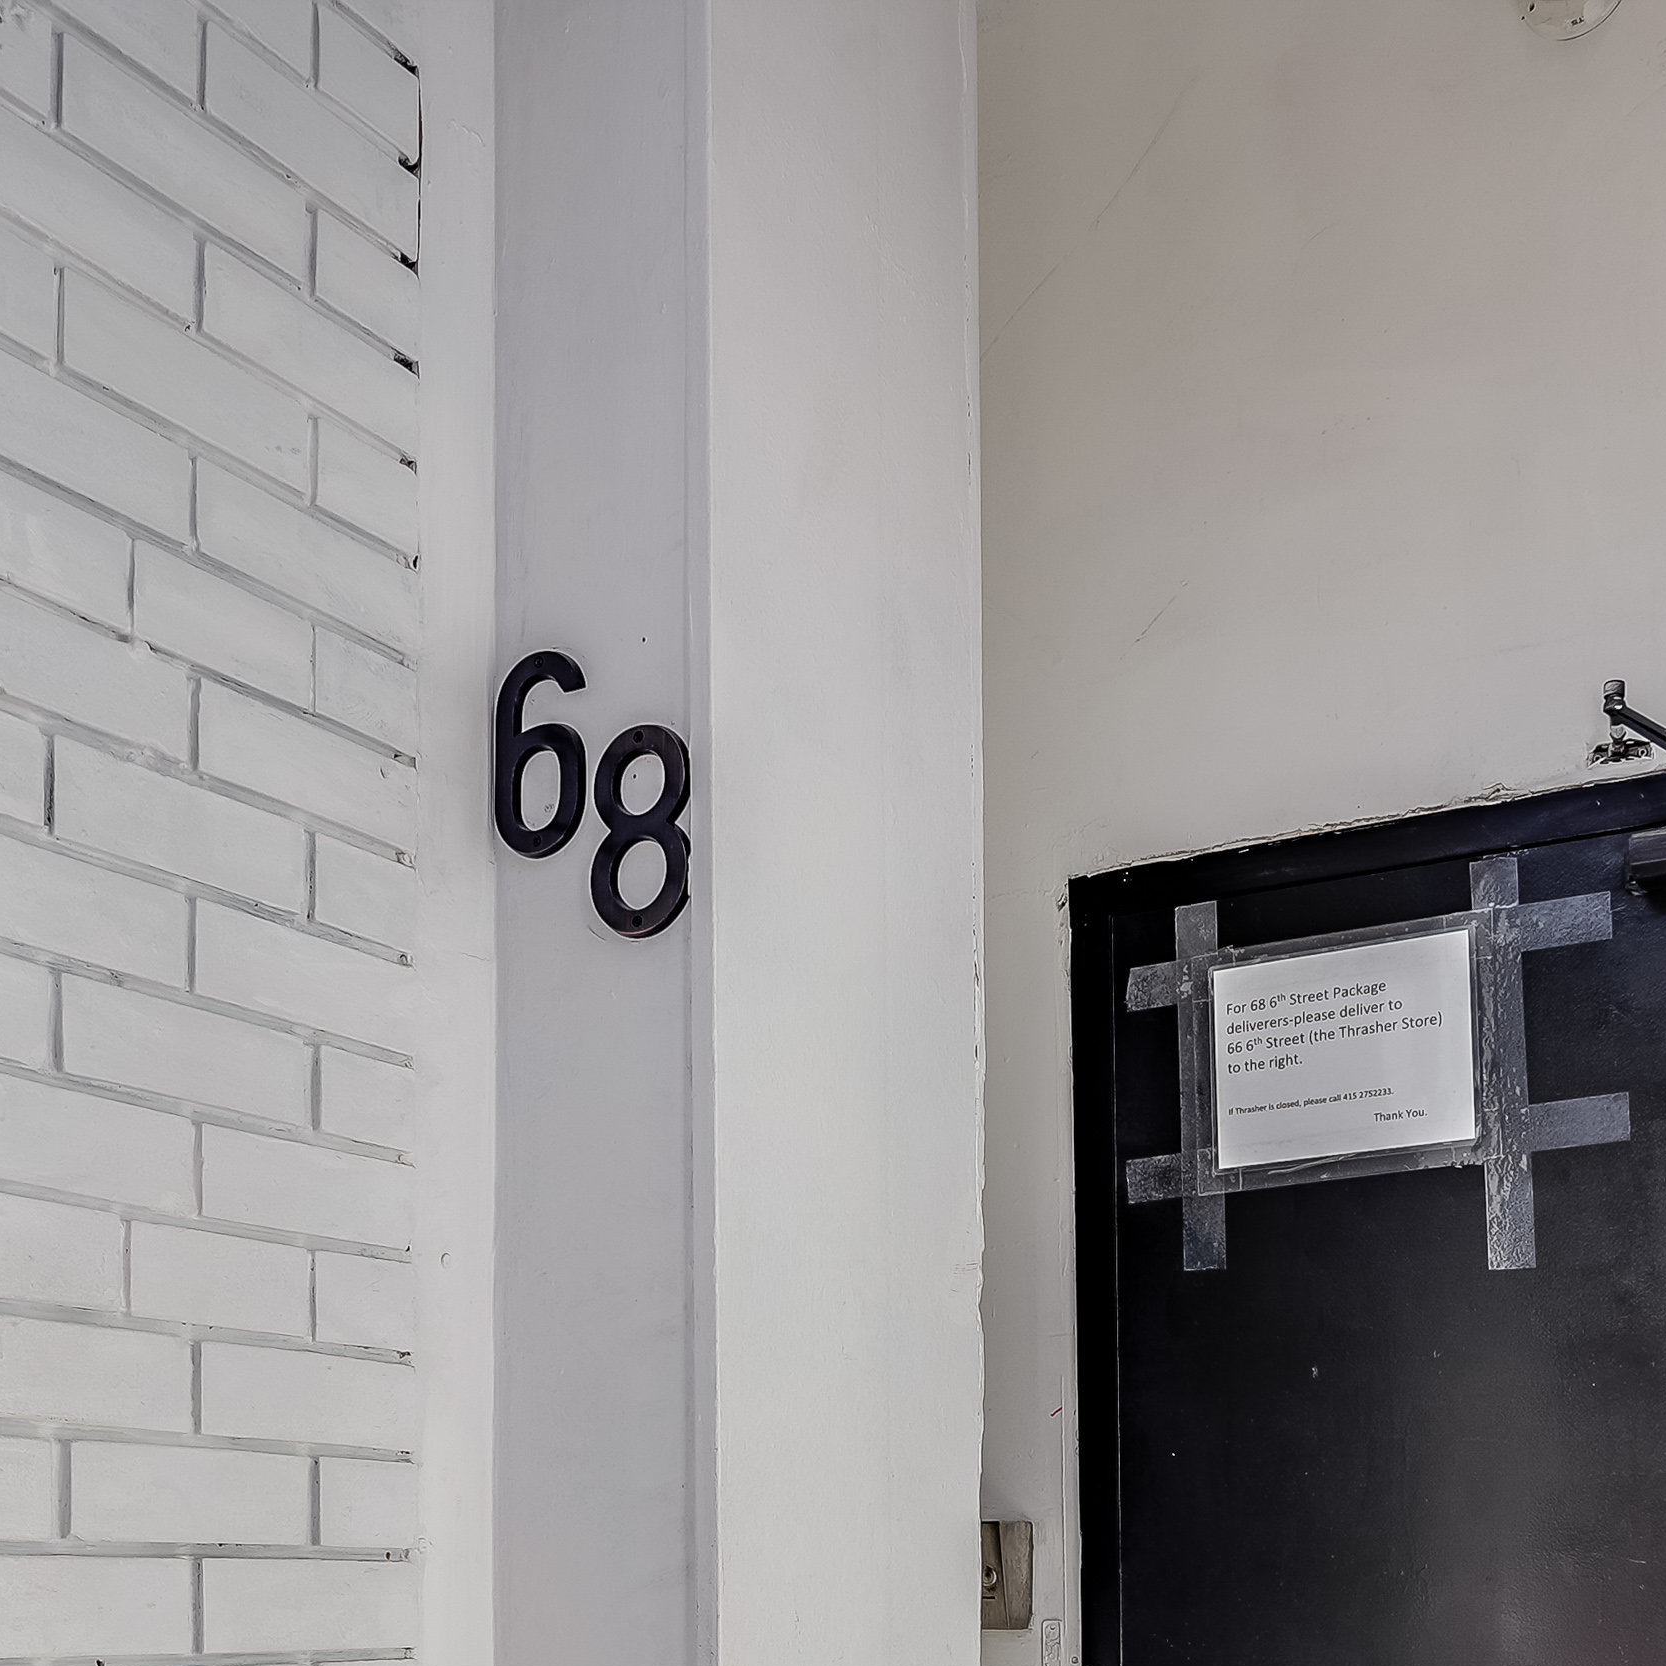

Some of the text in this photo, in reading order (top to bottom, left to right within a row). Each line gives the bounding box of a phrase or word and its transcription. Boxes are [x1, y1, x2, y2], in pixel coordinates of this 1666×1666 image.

[494, 649, 691, 940] 68
[1226, 982, 1386, 1015] For 68 6th Street Package
[1226, 1000, 1403, 1035] deliverers-please deliver to
[1227, 1011, 1443, 1055] 66 6th Street (the Thrasher Store)
[1228, 1053, 1303, 1074] to the right.
[1228, 1107, 1234, 1116] If
[1235, 1104, 1267, 1115] Thrasher
[1276, 1100, 1302, 1110] closed,
[1303, 1097, 1327, 1107] please
[1328, 1094, 1342, 1102] call
[1343, 1091, 1357, 1101] 415
[1359, 1087, 1394, 1099] 2752233.
[1374, 1107, 1428, 1122] Thank You.
